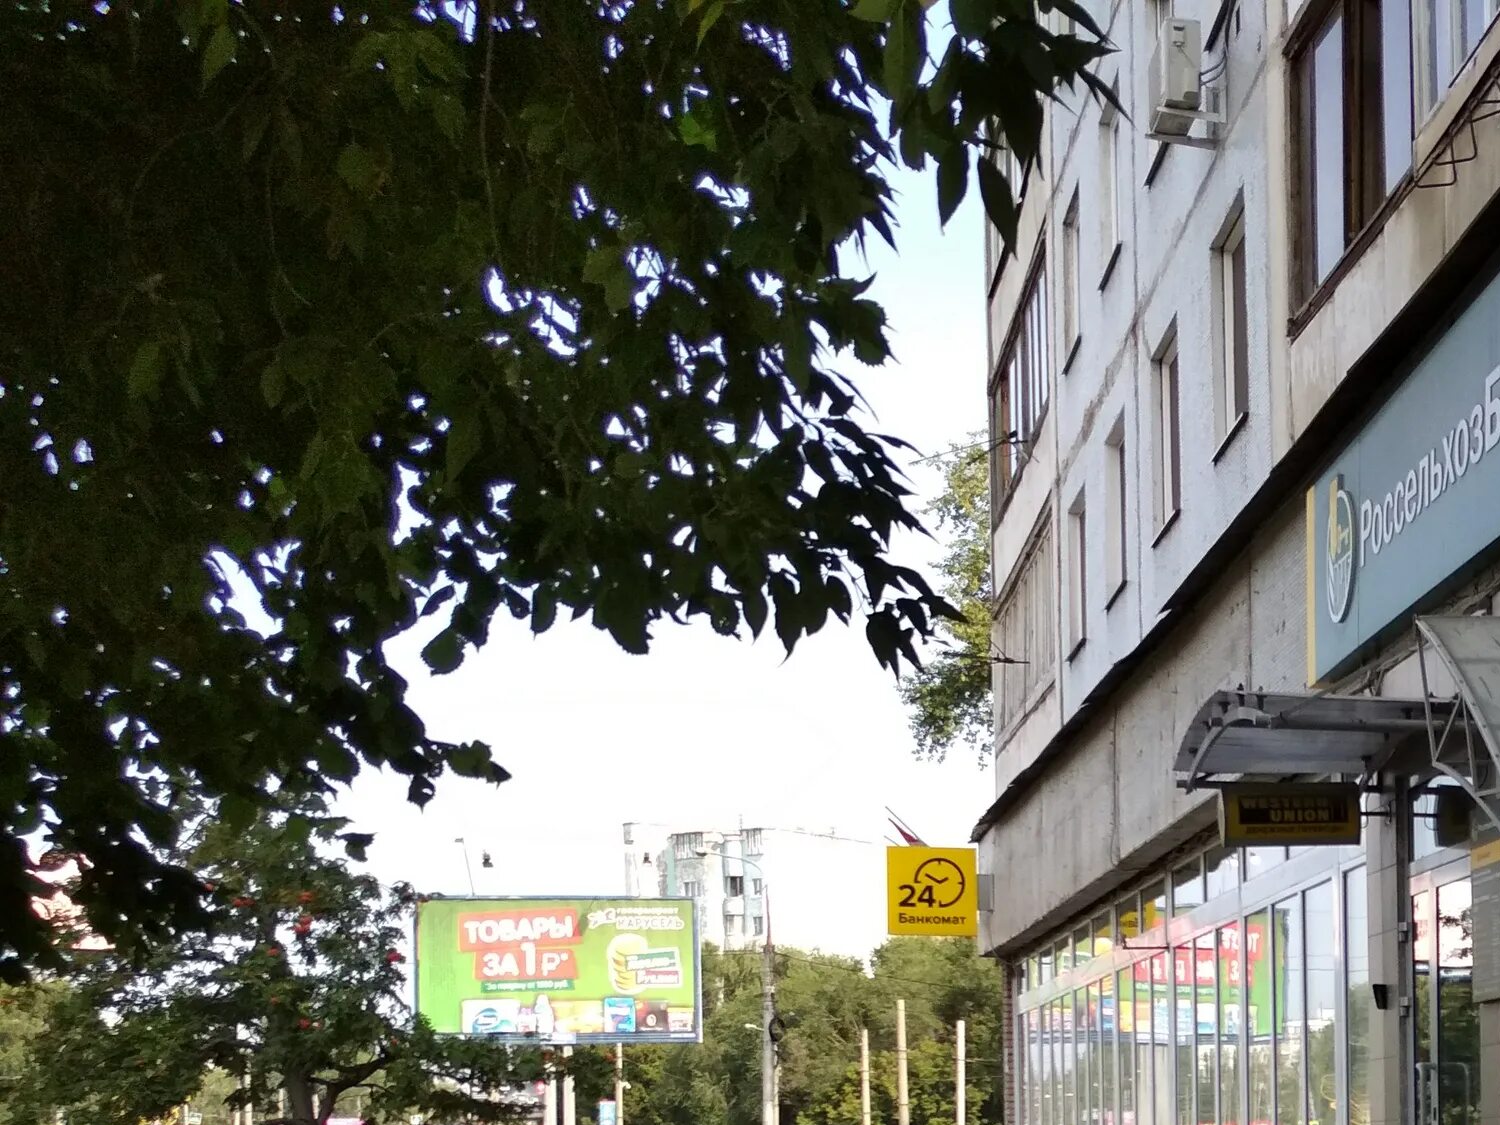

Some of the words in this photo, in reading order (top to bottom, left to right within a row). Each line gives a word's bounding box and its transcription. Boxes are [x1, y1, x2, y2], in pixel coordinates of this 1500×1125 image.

[1270, 809, 1329, 822] UNION
[898, 884, 936, 908] 24
[463, 915, 574, 944] ТОВАРЫ
[898, 913, 967, 925] Банкомат
[482, 951, 520, 977] ЗА
[520, 940, 537, 976] 1
